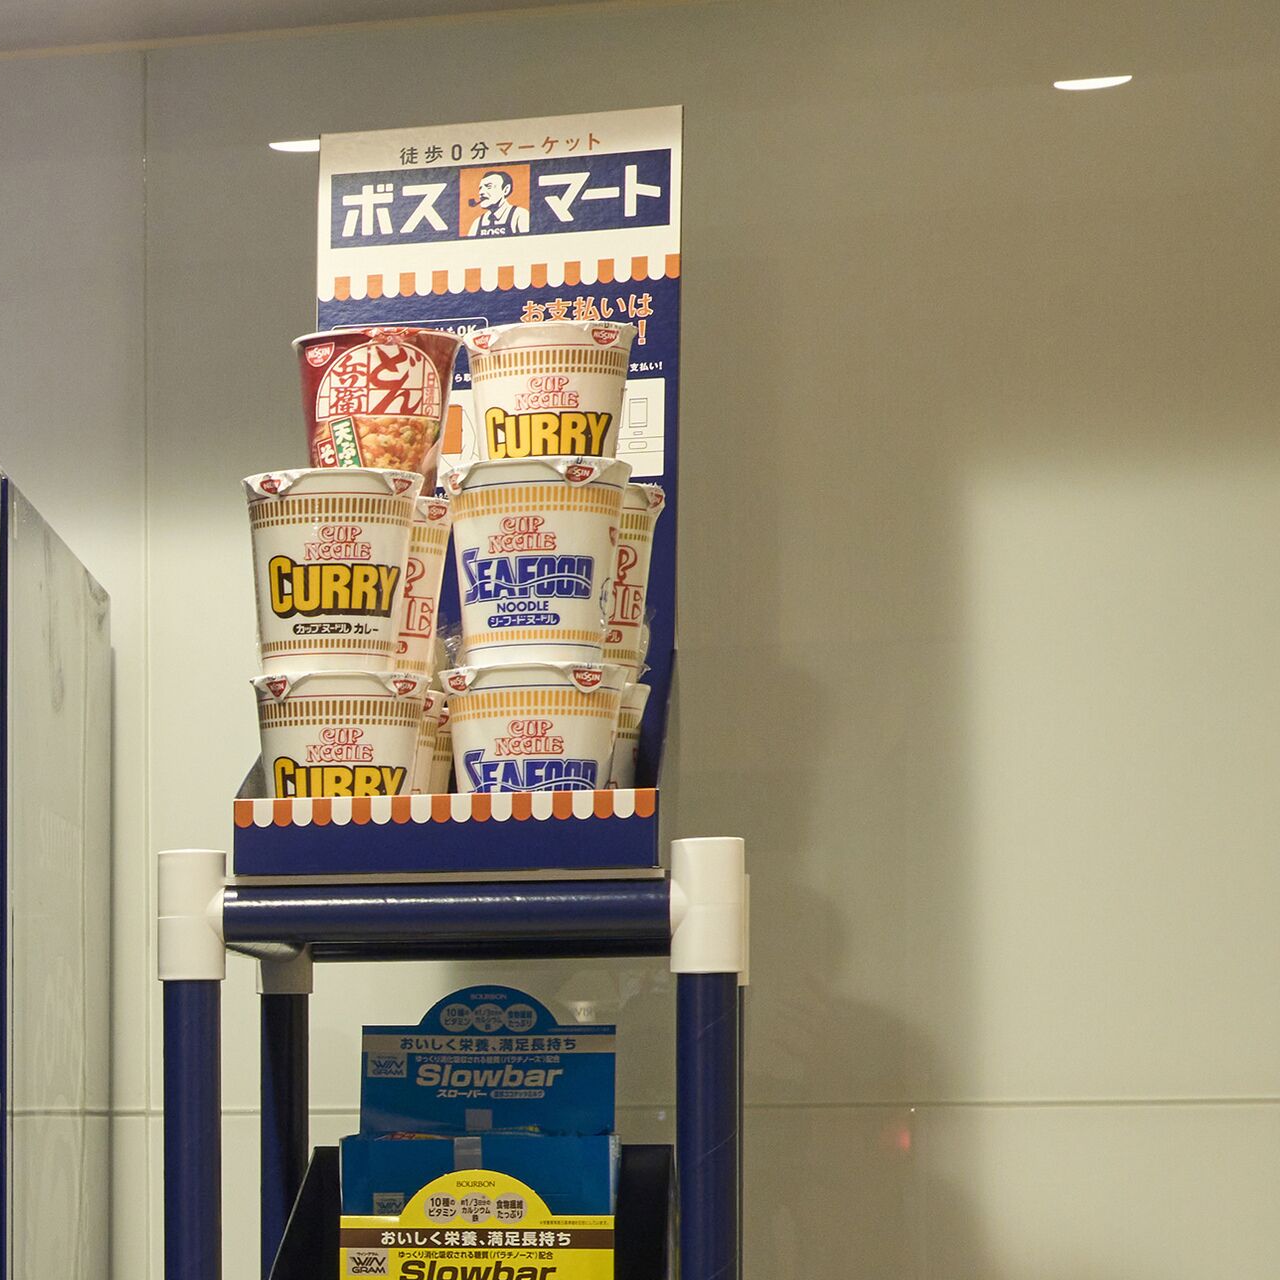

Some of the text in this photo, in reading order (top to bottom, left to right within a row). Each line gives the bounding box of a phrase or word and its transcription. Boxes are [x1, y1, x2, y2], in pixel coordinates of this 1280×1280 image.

[342, 165, 661, 237] ボス マート
[485, 407, 613, 459] CURRY
[462, 548, 594, 602] SEAFOOD
[269, 556, 401, 618] CURRY
[497, 601, 549, 613] NOODLE
[490, 614, 558, 626] シーフードヌードル
[353, 624, 379, 635] カレー
[400, 1038, 577, 1052] おいしく栄養、満足長持ち
[416, 1064, 563, 1087] Slowbar
[436, 1090, 486, 1098] スローバー
[428, 1208, 456, 1217] ビタミン
[461, 1207, 490, 1215] カルシウム
[381, 1231, 571, 1247] おいしく栄養、満足長持ち
[351, 1256, 386, 1266] WIN
